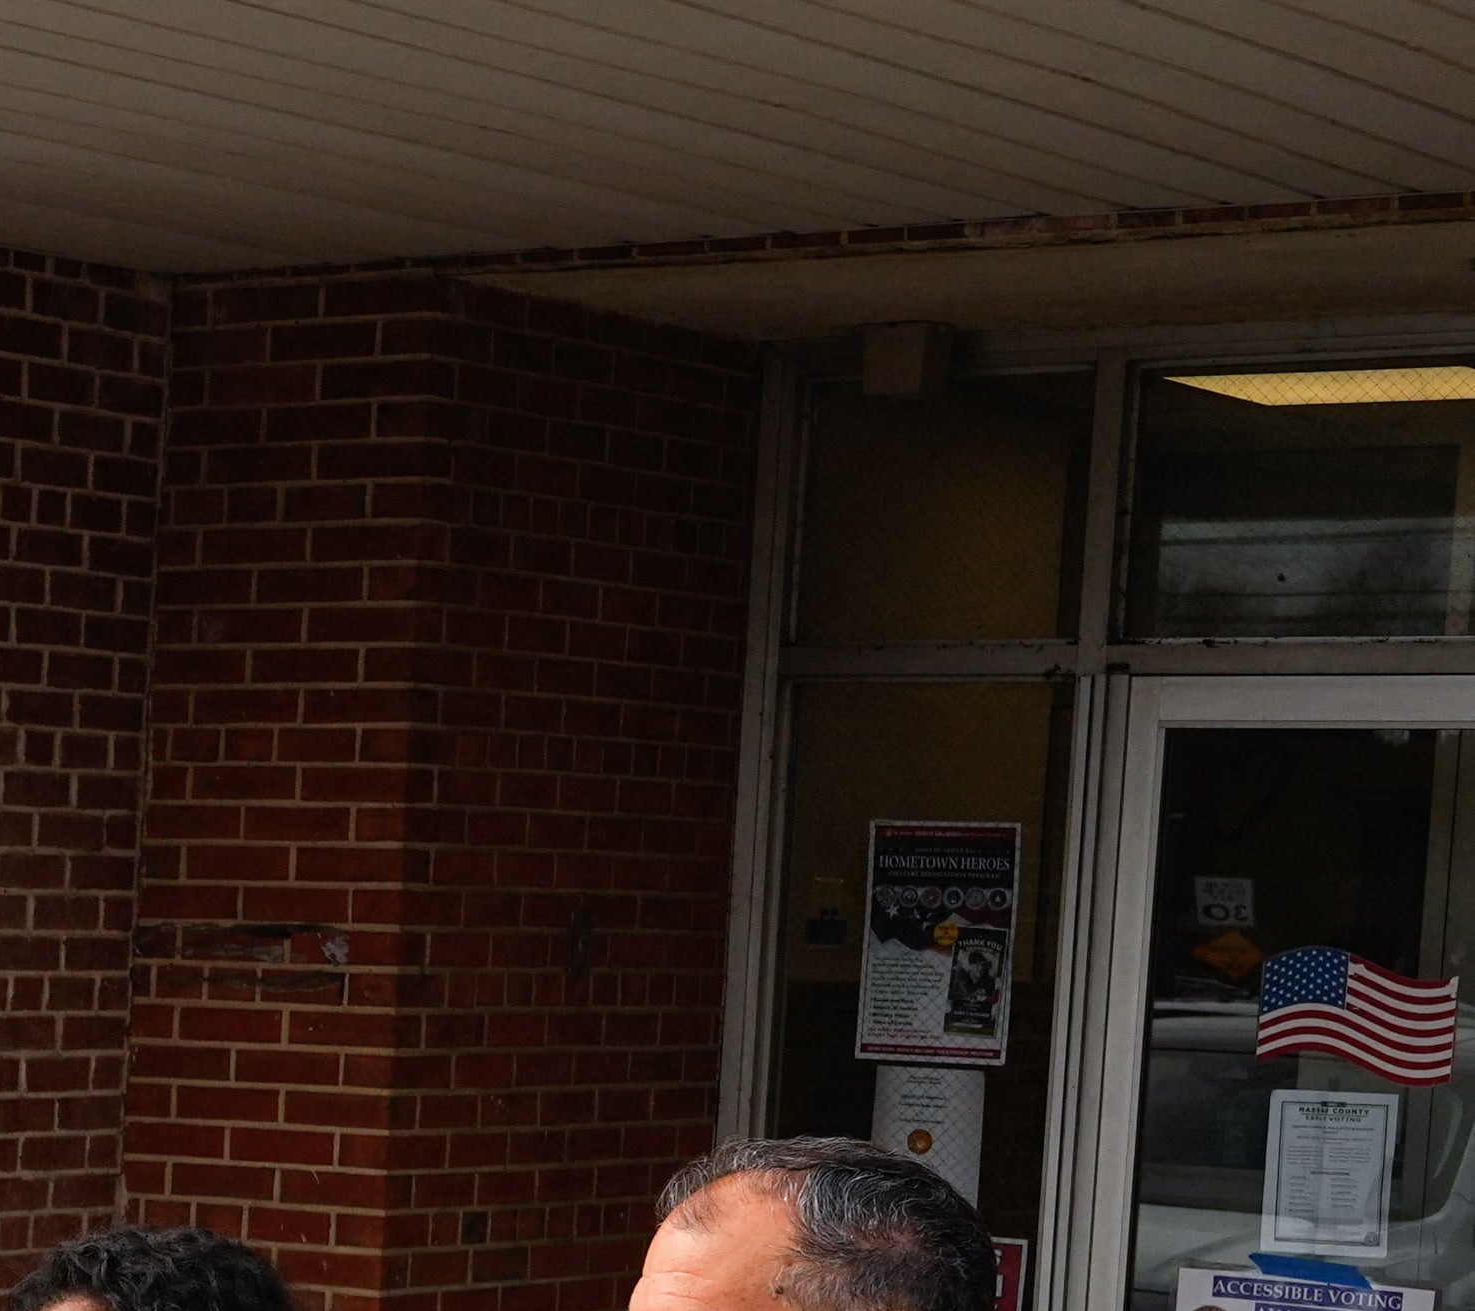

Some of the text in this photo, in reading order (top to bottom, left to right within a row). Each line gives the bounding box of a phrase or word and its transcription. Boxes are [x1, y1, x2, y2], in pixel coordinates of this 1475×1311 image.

[878, 855, 1010, 871] HOMETOWN HEROES
[958, 939, 1004, 951] THANK YOU
[1213, 1279, 1402, 1311] ACCESSIBLE VOTING
